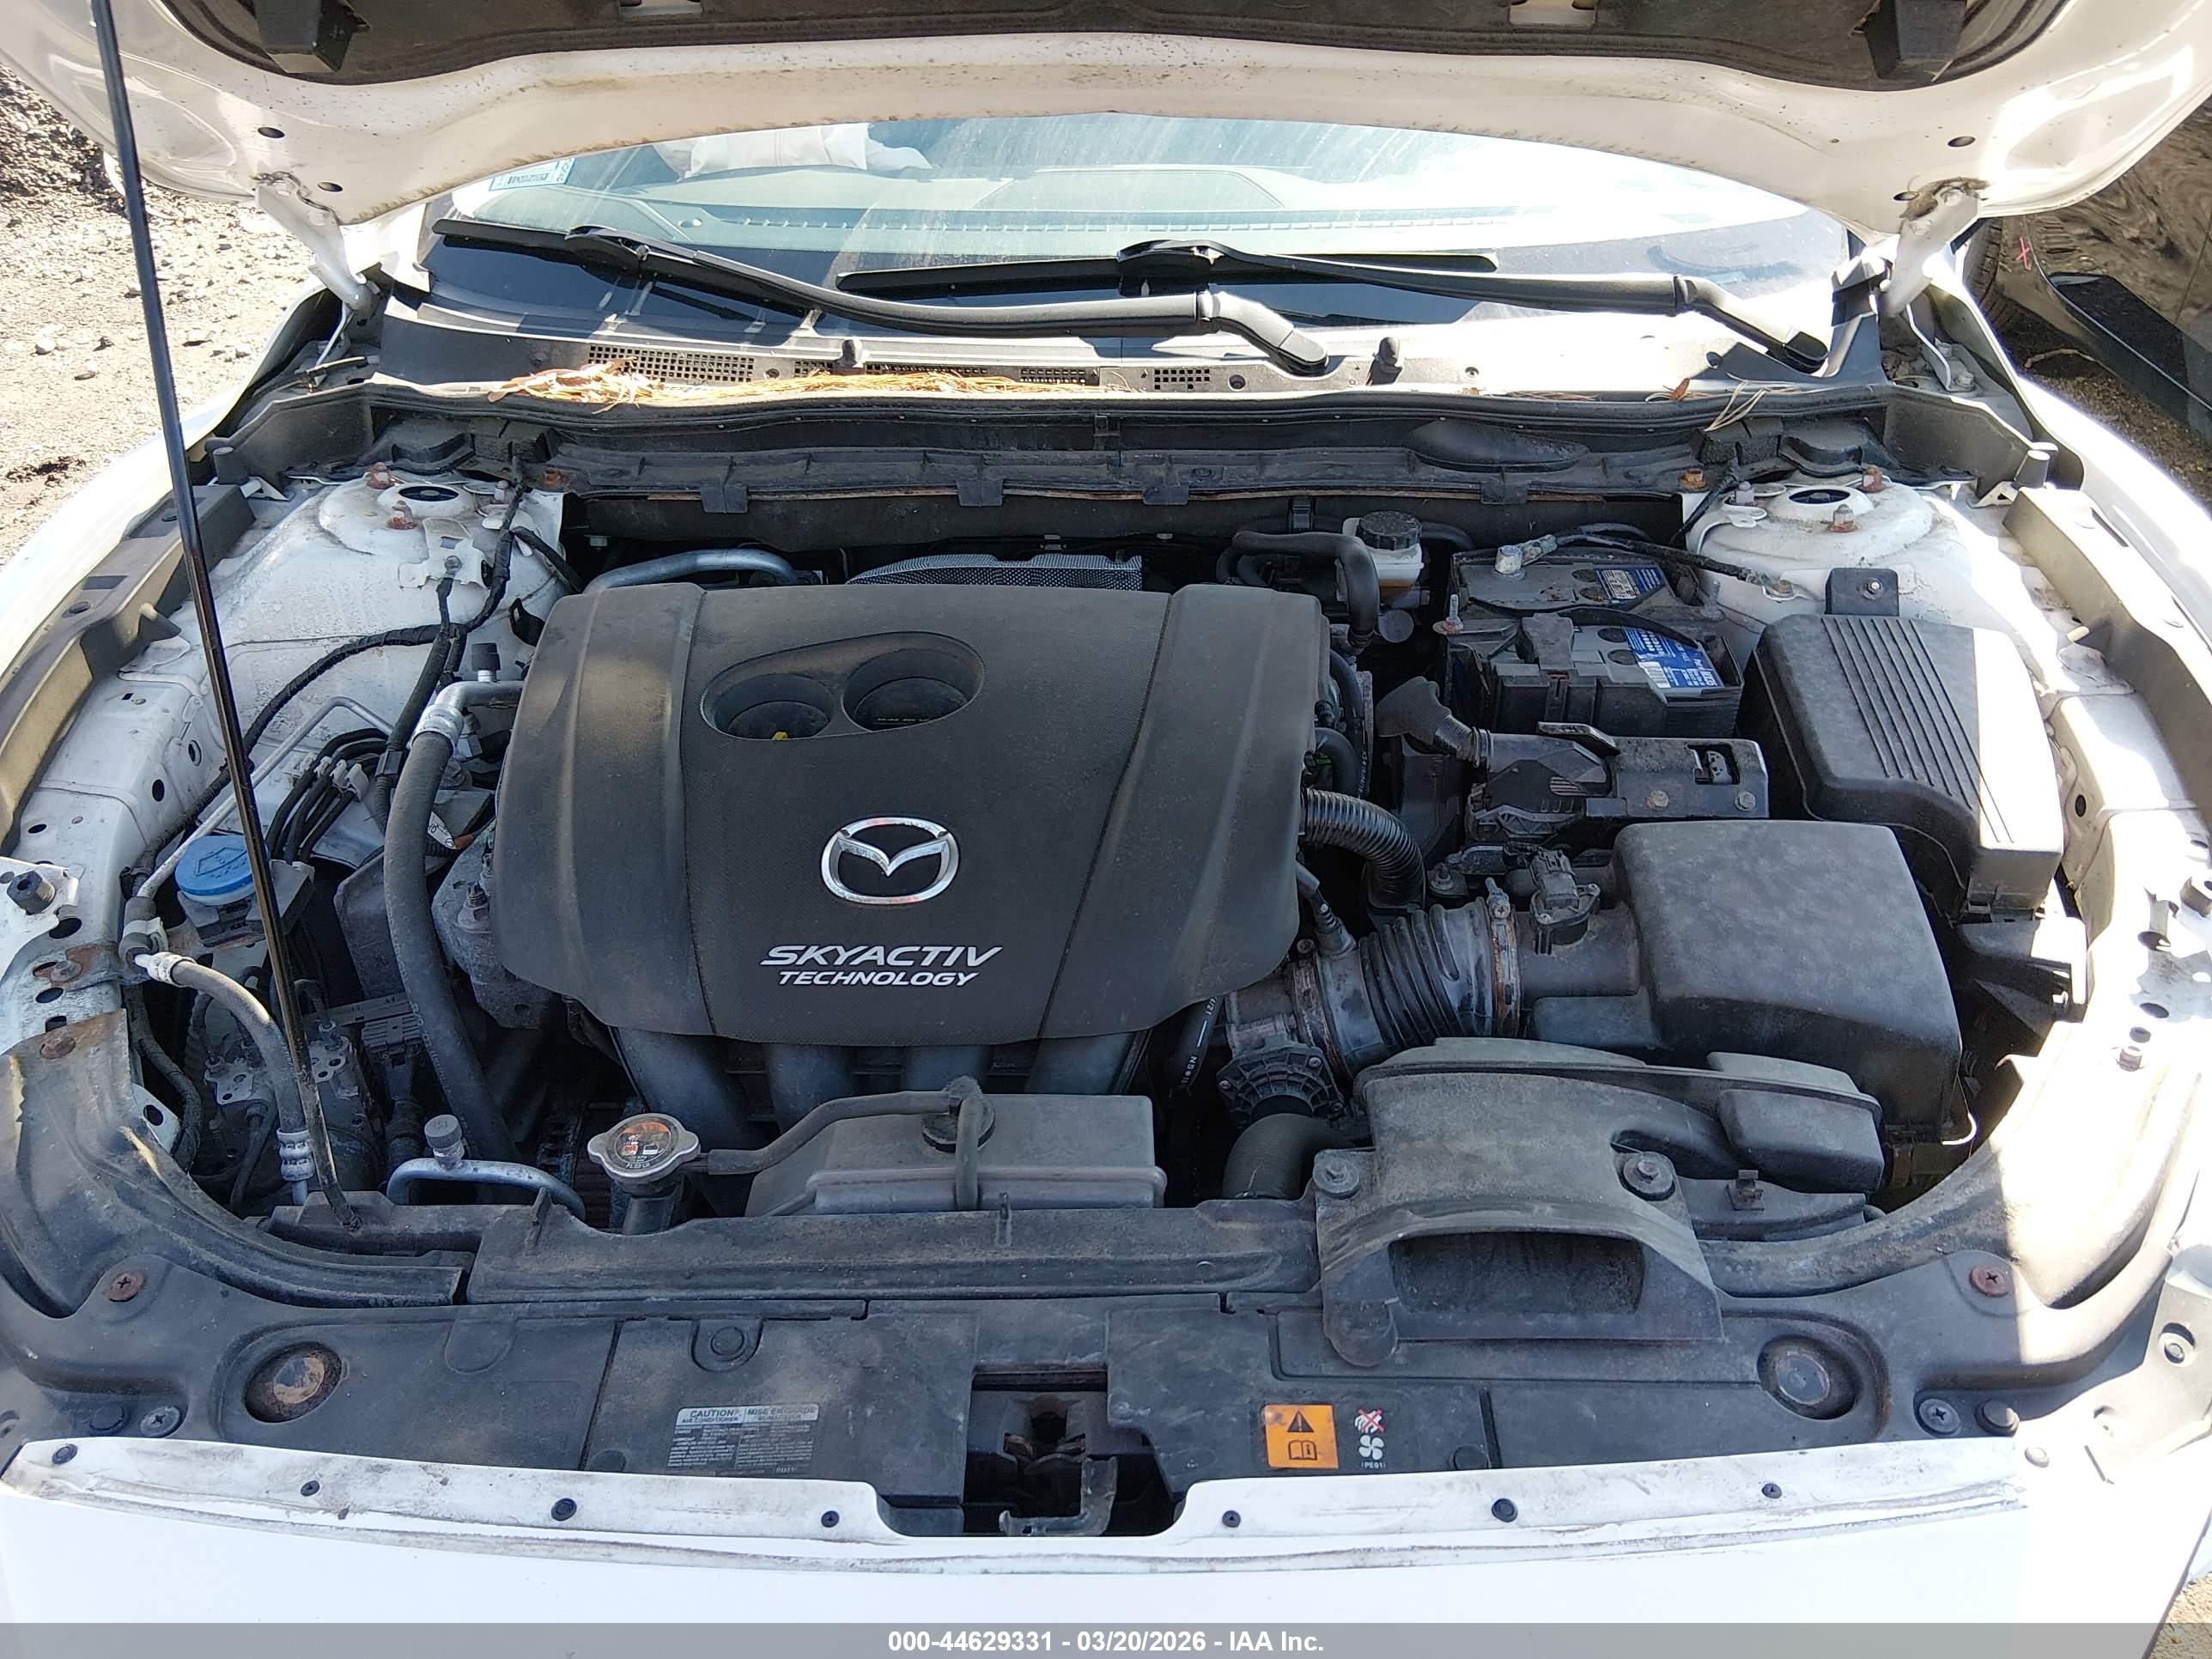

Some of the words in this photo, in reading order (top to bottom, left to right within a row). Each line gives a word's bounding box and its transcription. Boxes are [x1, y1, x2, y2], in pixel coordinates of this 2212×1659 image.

[760, 945, 1003, 967] SKYACTIV
[779, 971, 980, 987] TECHNOLOGY
[690, 1409, 734, 1418] CAUTION
